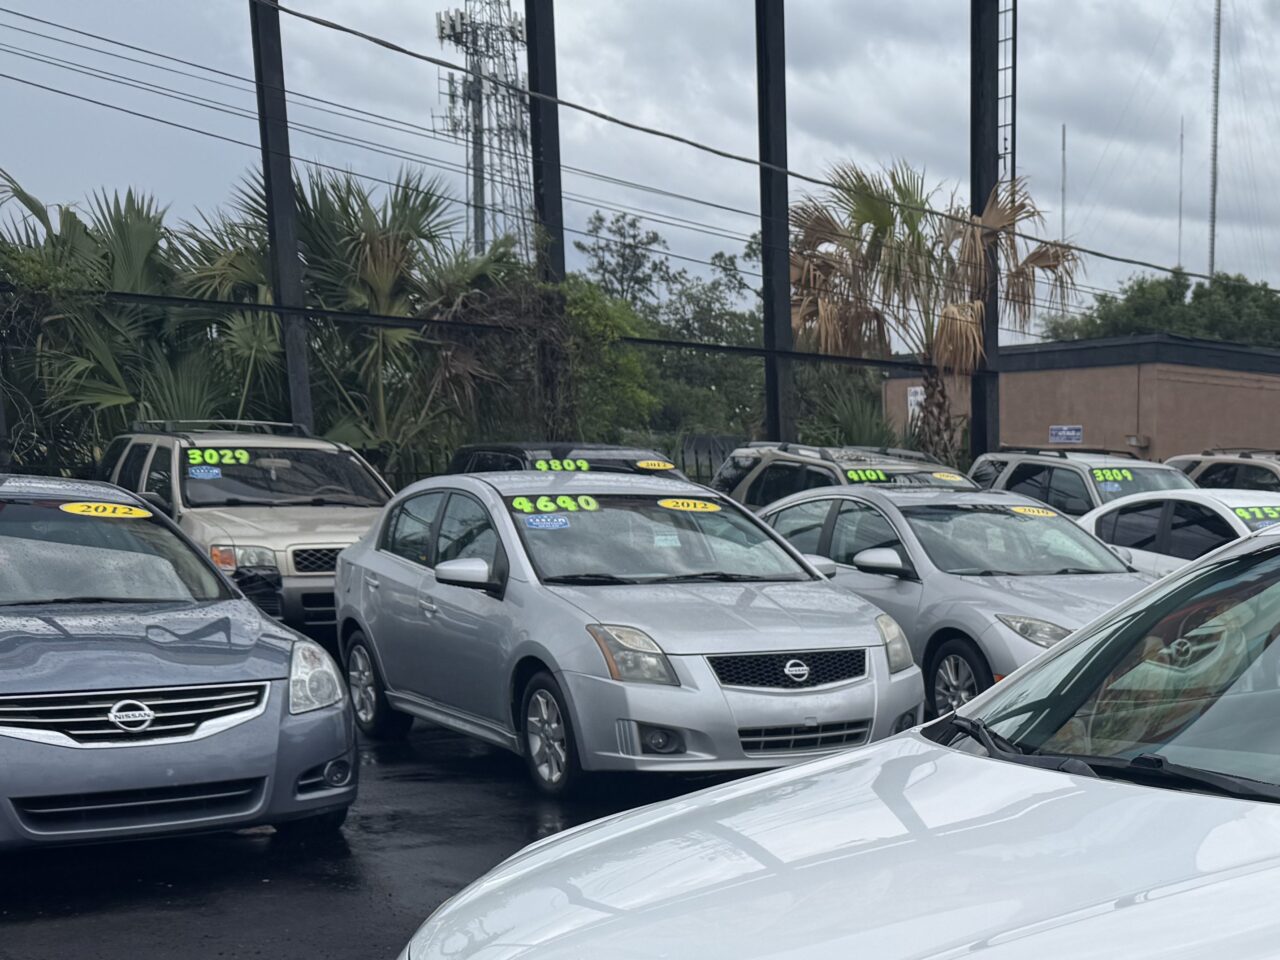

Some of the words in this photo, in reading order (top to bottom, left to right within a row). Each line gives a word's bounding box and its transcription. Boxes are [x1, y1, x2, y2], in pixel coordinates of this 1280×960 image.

[187, 448, 250, 465] 3029
[535, 459, 590, 472] 4809
[847, 468, 888, 482] 4101
[1093, 468, 1134, 482] 3809
[80, 504, 134, 515] 2012
[511, 495, 599, 513] 4640
[672, 500, 709, 510] 2012
[113, 711, 151, 721] NISSAN
